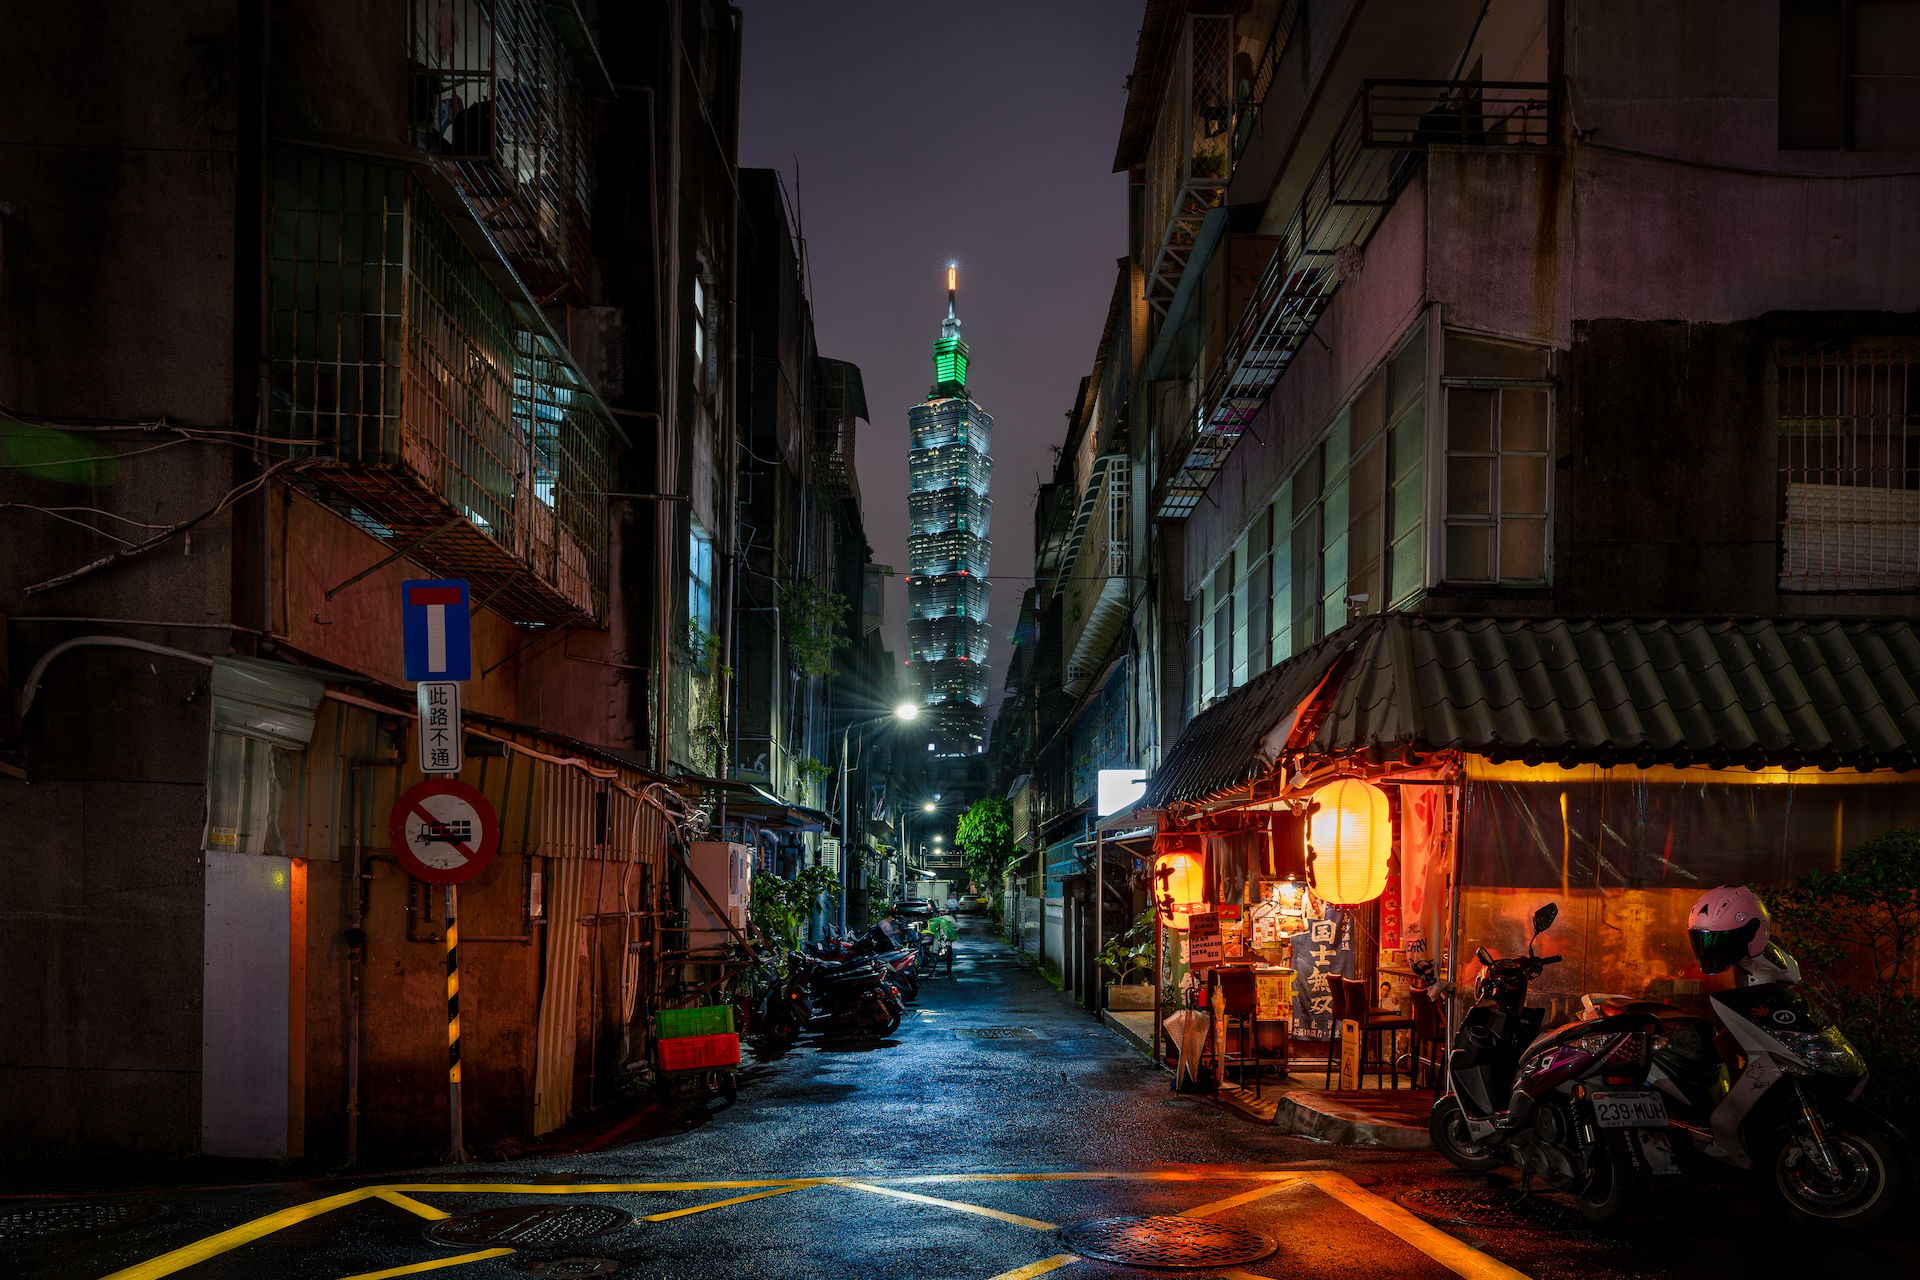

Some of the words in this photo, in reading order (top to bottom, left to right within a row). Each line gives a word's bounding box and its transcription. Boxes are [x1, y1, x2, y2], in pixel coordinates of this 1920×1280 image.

[430, 687, 449, 767] 此路不通
[1307, 919, 1337, 1015] 国士無双
[1598, 1103, 1666, 1121] 239-MUH
